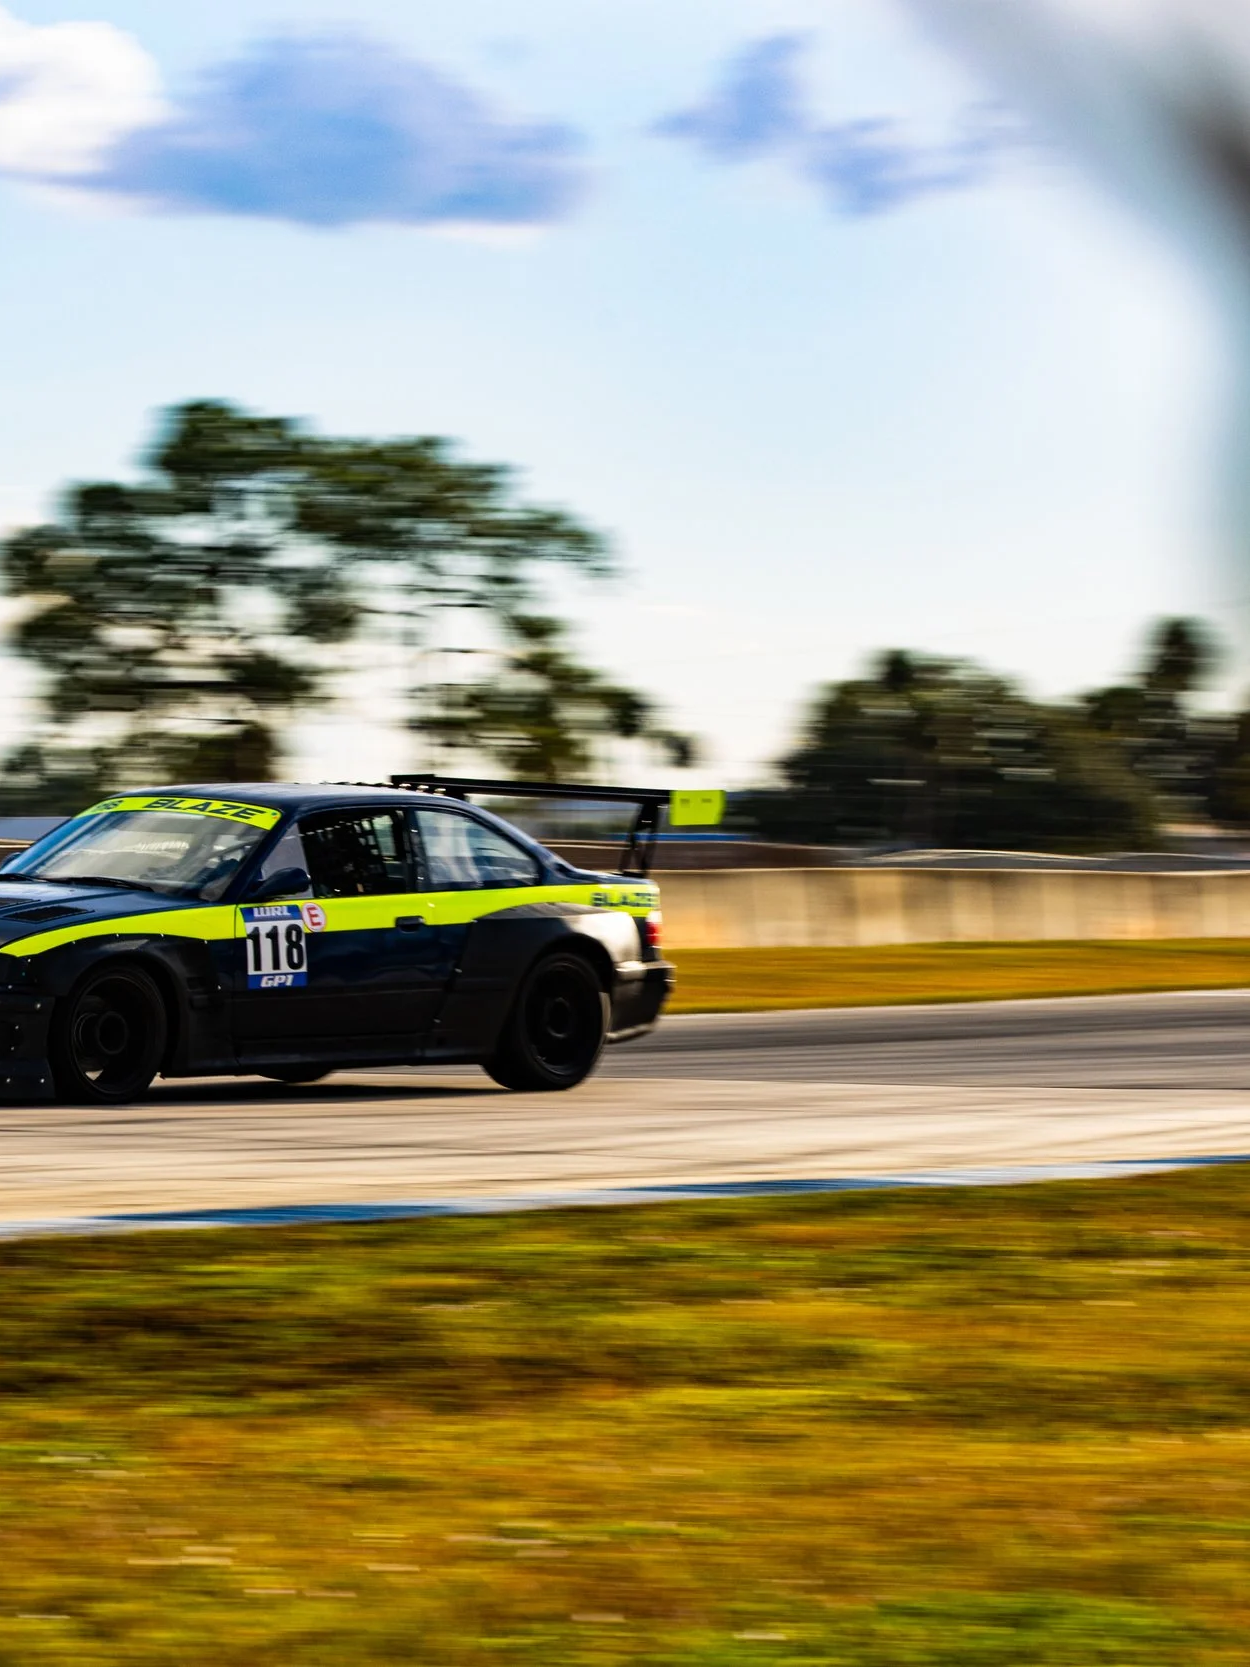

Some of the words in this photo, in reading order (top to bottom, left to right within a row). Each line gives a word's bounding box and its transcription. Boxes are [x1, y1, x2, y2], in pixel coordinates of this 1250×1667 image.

[142, 799, 266, 819] BLAZE
[253, 906, 291, 918] WRL
[306, 907, 322, 926] E
[246, 924, 304, 972] 118
